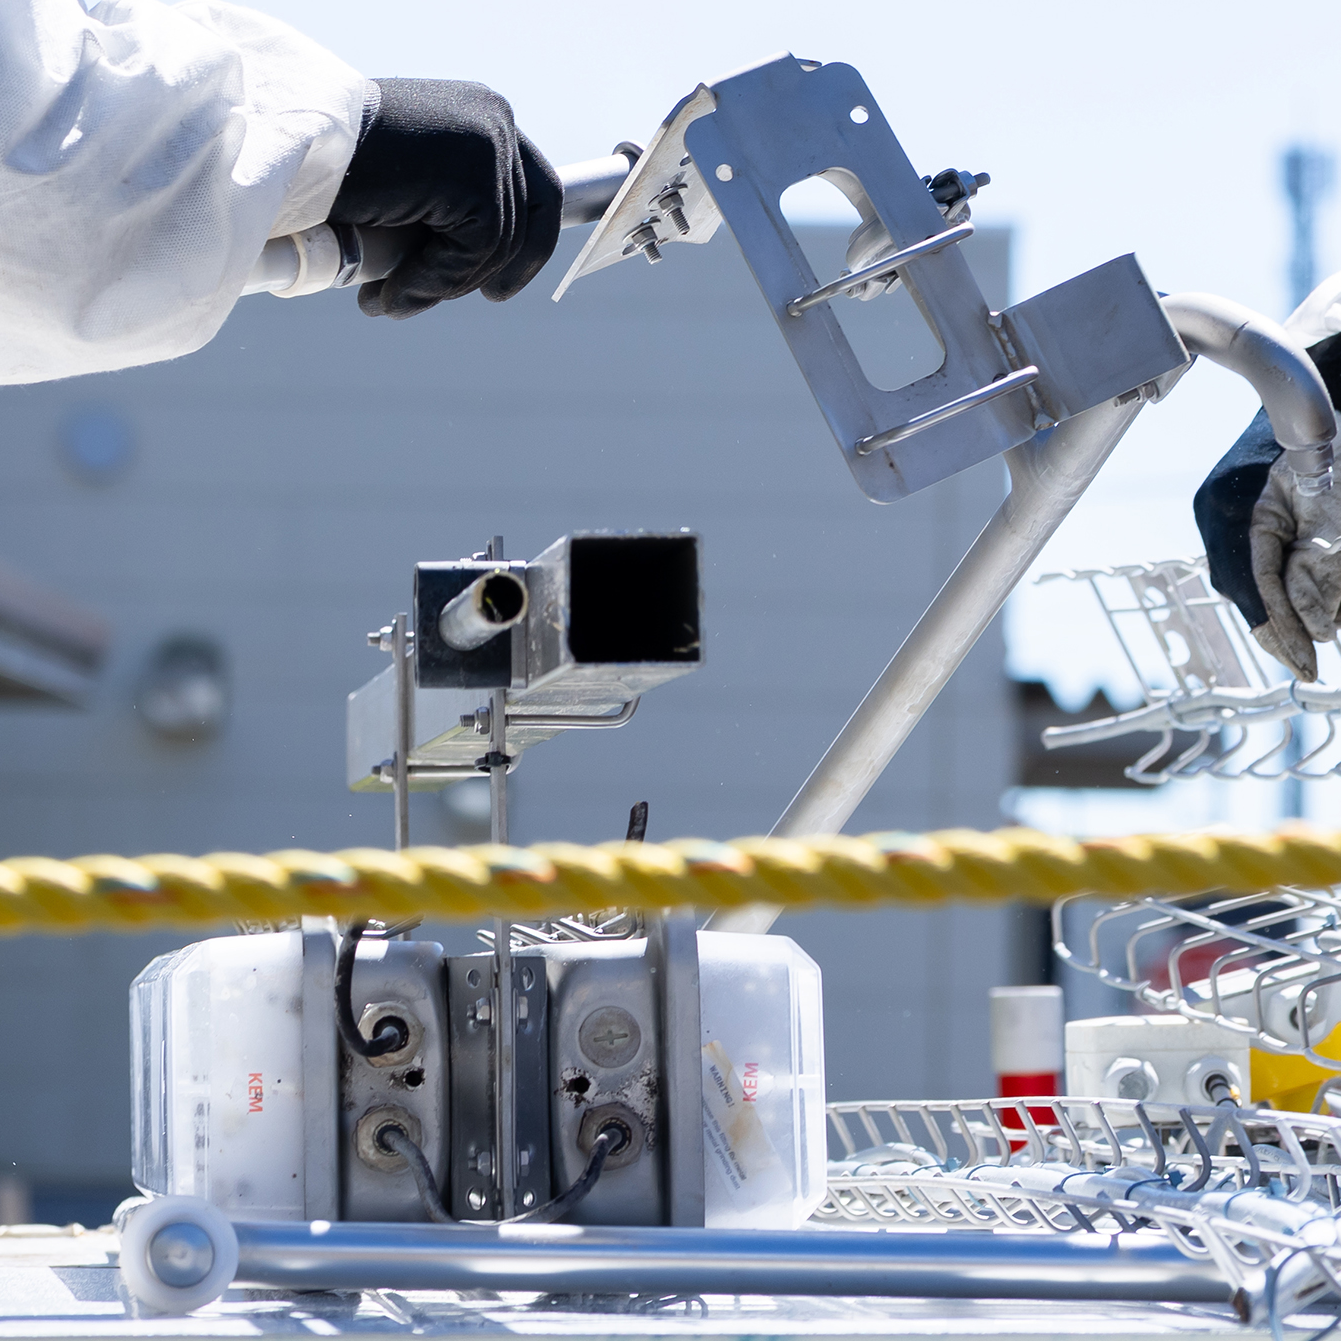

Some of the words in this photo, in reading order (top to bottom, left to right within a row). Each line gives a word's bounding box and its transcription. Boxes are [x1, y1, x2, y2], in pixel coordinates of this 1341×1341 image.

[248, 1072, 263, 1113] KEM
[709, 1064, 735, 1108] WARNING!
[742, 1062, 759, 1103] KEM
